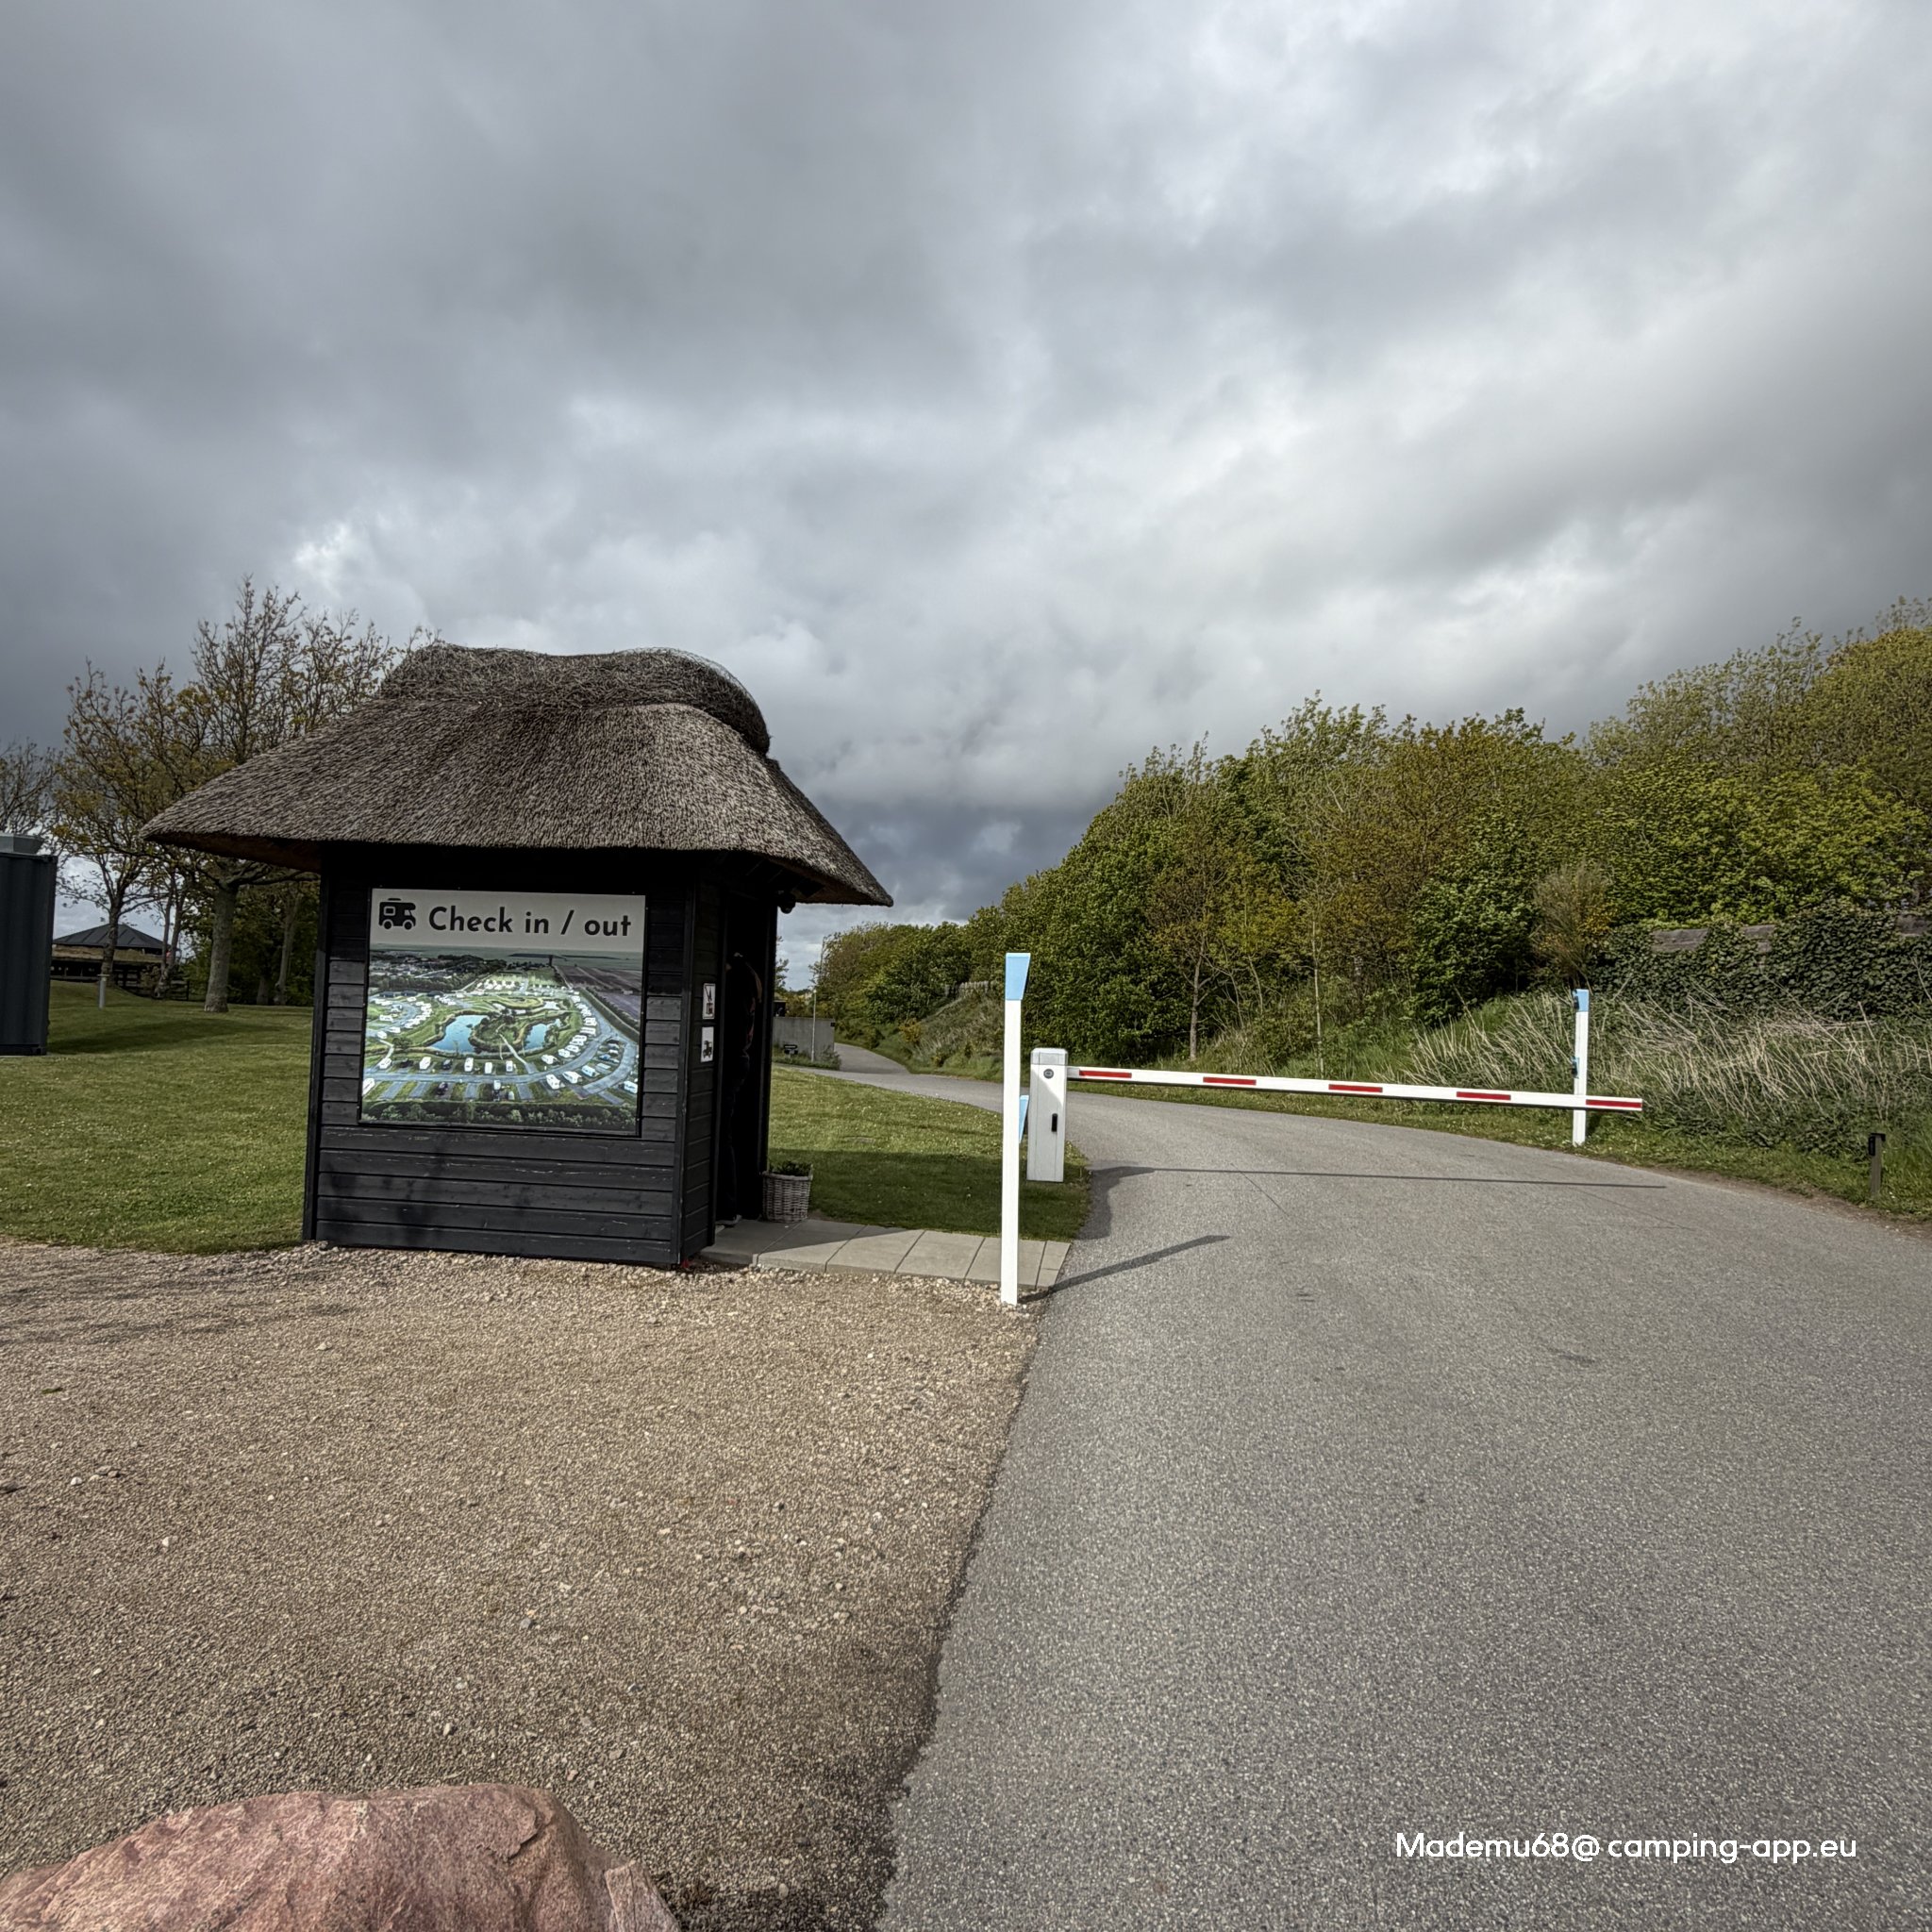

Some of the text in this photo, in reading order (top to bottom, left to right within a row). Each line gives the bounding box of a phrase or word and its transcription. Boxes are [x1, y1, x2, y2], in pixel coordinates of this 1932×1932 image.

[428, 905, 632, 937] Check in / out
